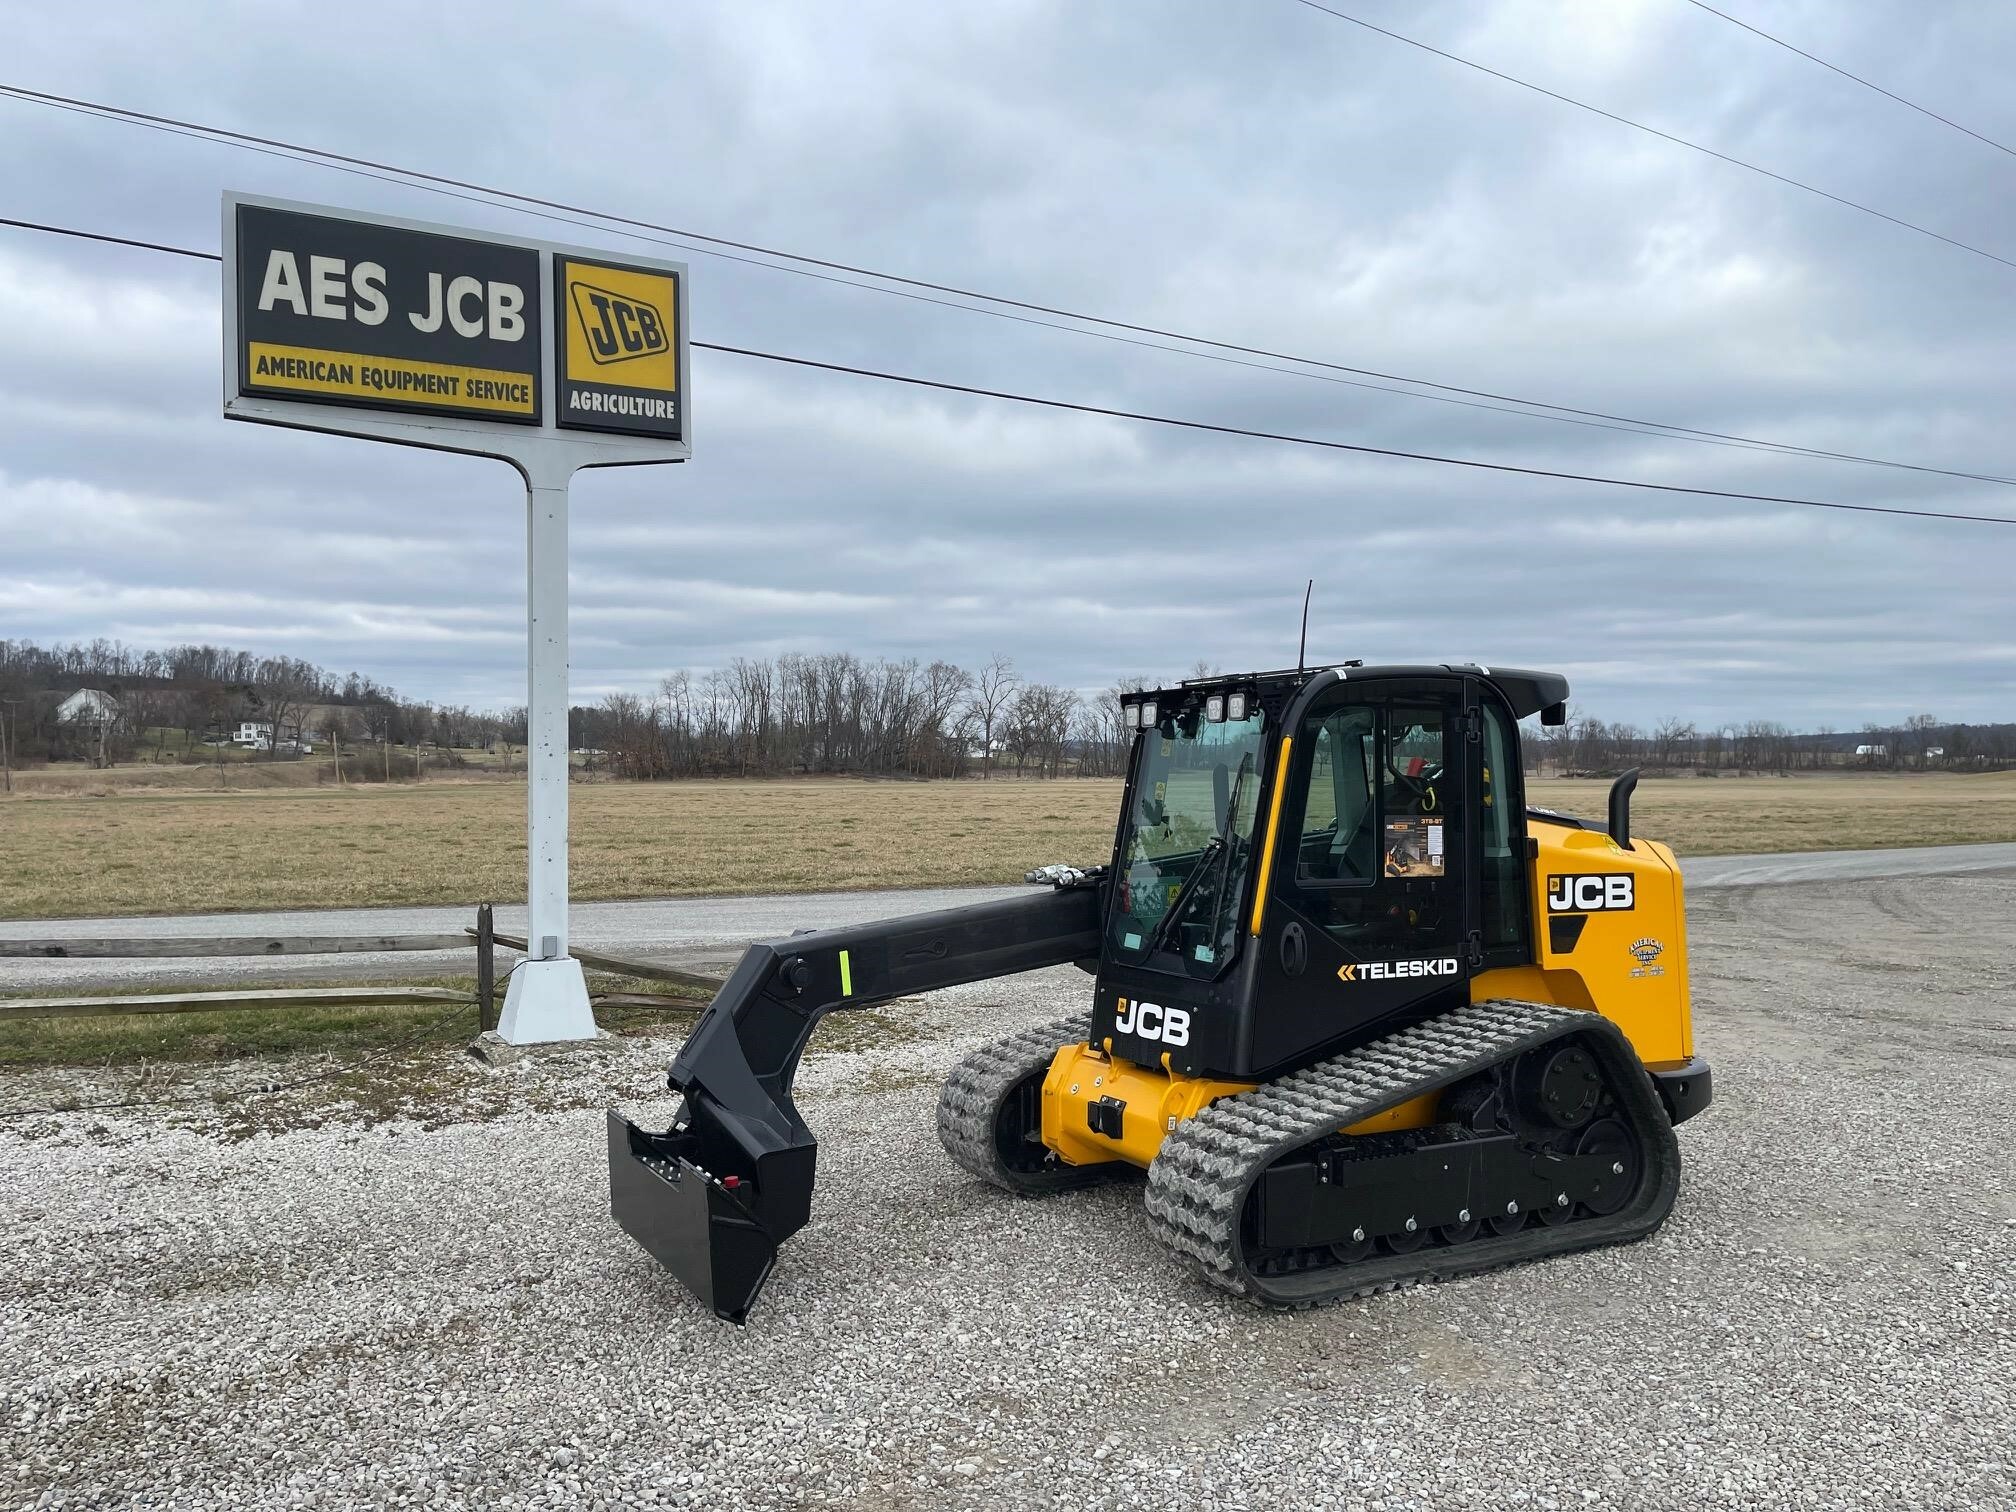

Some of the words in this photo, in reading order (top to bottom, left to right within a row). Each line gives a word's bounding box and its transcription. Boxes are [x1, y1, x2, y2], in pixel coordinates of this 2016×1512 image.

[257, 249, 390, 326] AES
[408, 272, 526, 342] JCB
[589, 292, 662, 356] JCB
[256, 355, 354, 385] AMERICAN
[361, 366, 460, 396] EQUIPMENT
[466, 378, 530, 404] SERVICE
[569, 390, 676, 420] AGRICULTURE
[1549, 876, 1634, 911] JCB
[1356, 958, 1459, 980] TELESKID
[1115, 999, 1191, 1047] JCB
